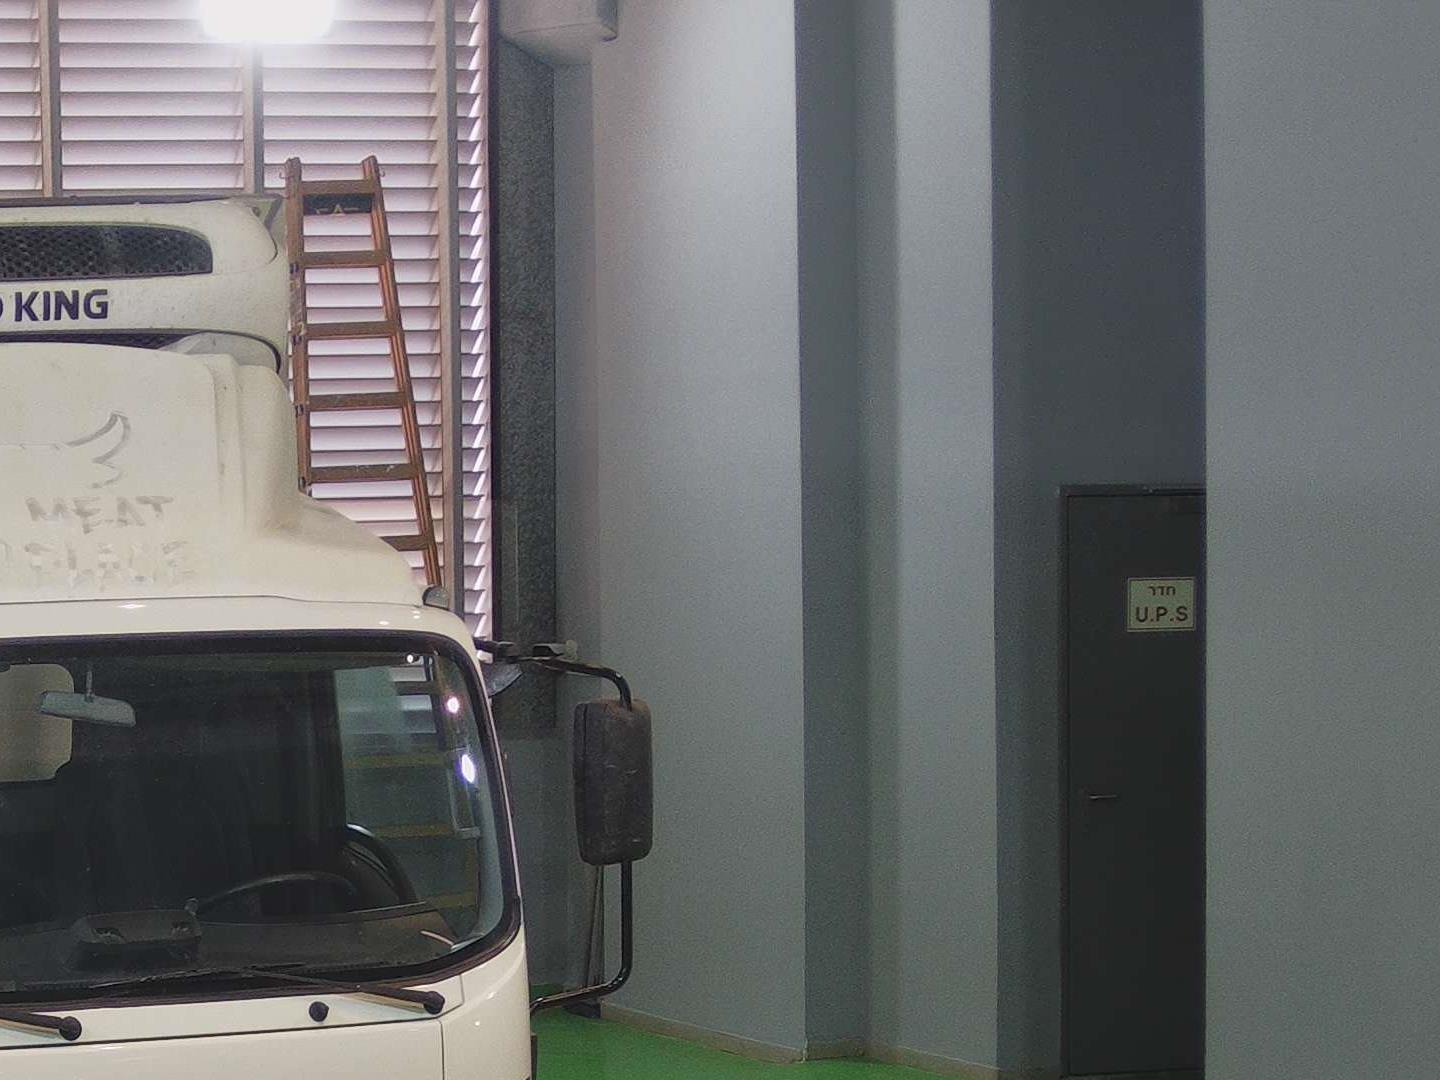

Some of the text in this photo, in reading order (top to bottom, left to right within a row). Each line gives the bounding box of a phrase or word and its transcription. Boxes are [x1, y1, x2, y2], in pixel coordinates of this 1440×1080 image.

[14, 289, 109, 322] KING
[1147, 586, 1176, 596] חדר
[1135, 606, 1189, 623] U.P.S
